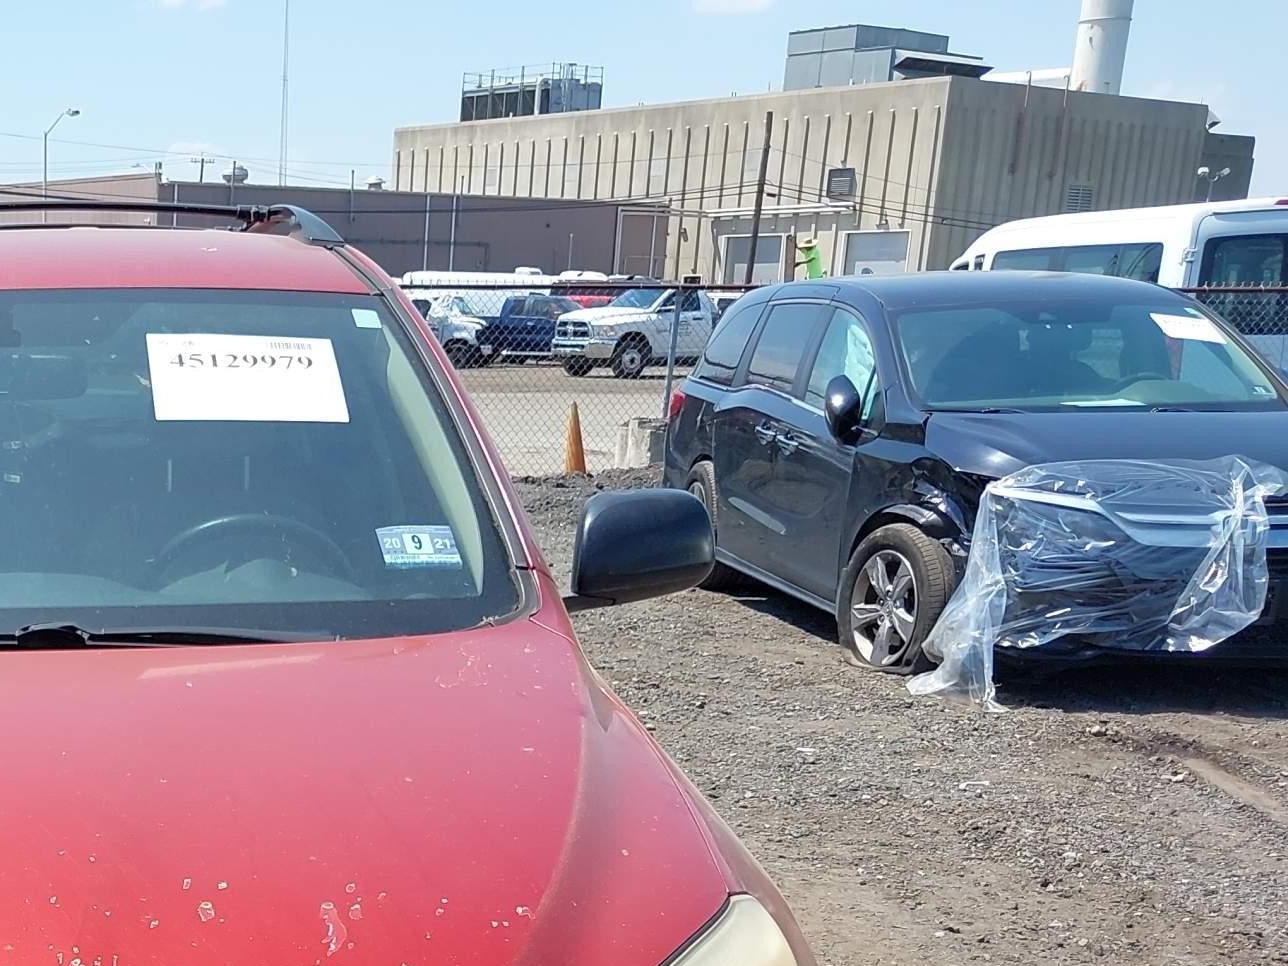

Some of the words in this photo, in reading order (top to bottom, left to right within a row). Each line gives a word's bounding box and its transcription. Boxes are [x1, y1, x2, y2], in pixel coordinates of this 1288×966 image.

[169, 353, 313, 370] 45129979
[383, 537, 401, 549] 20
[411, 534, 423, 550] 9
